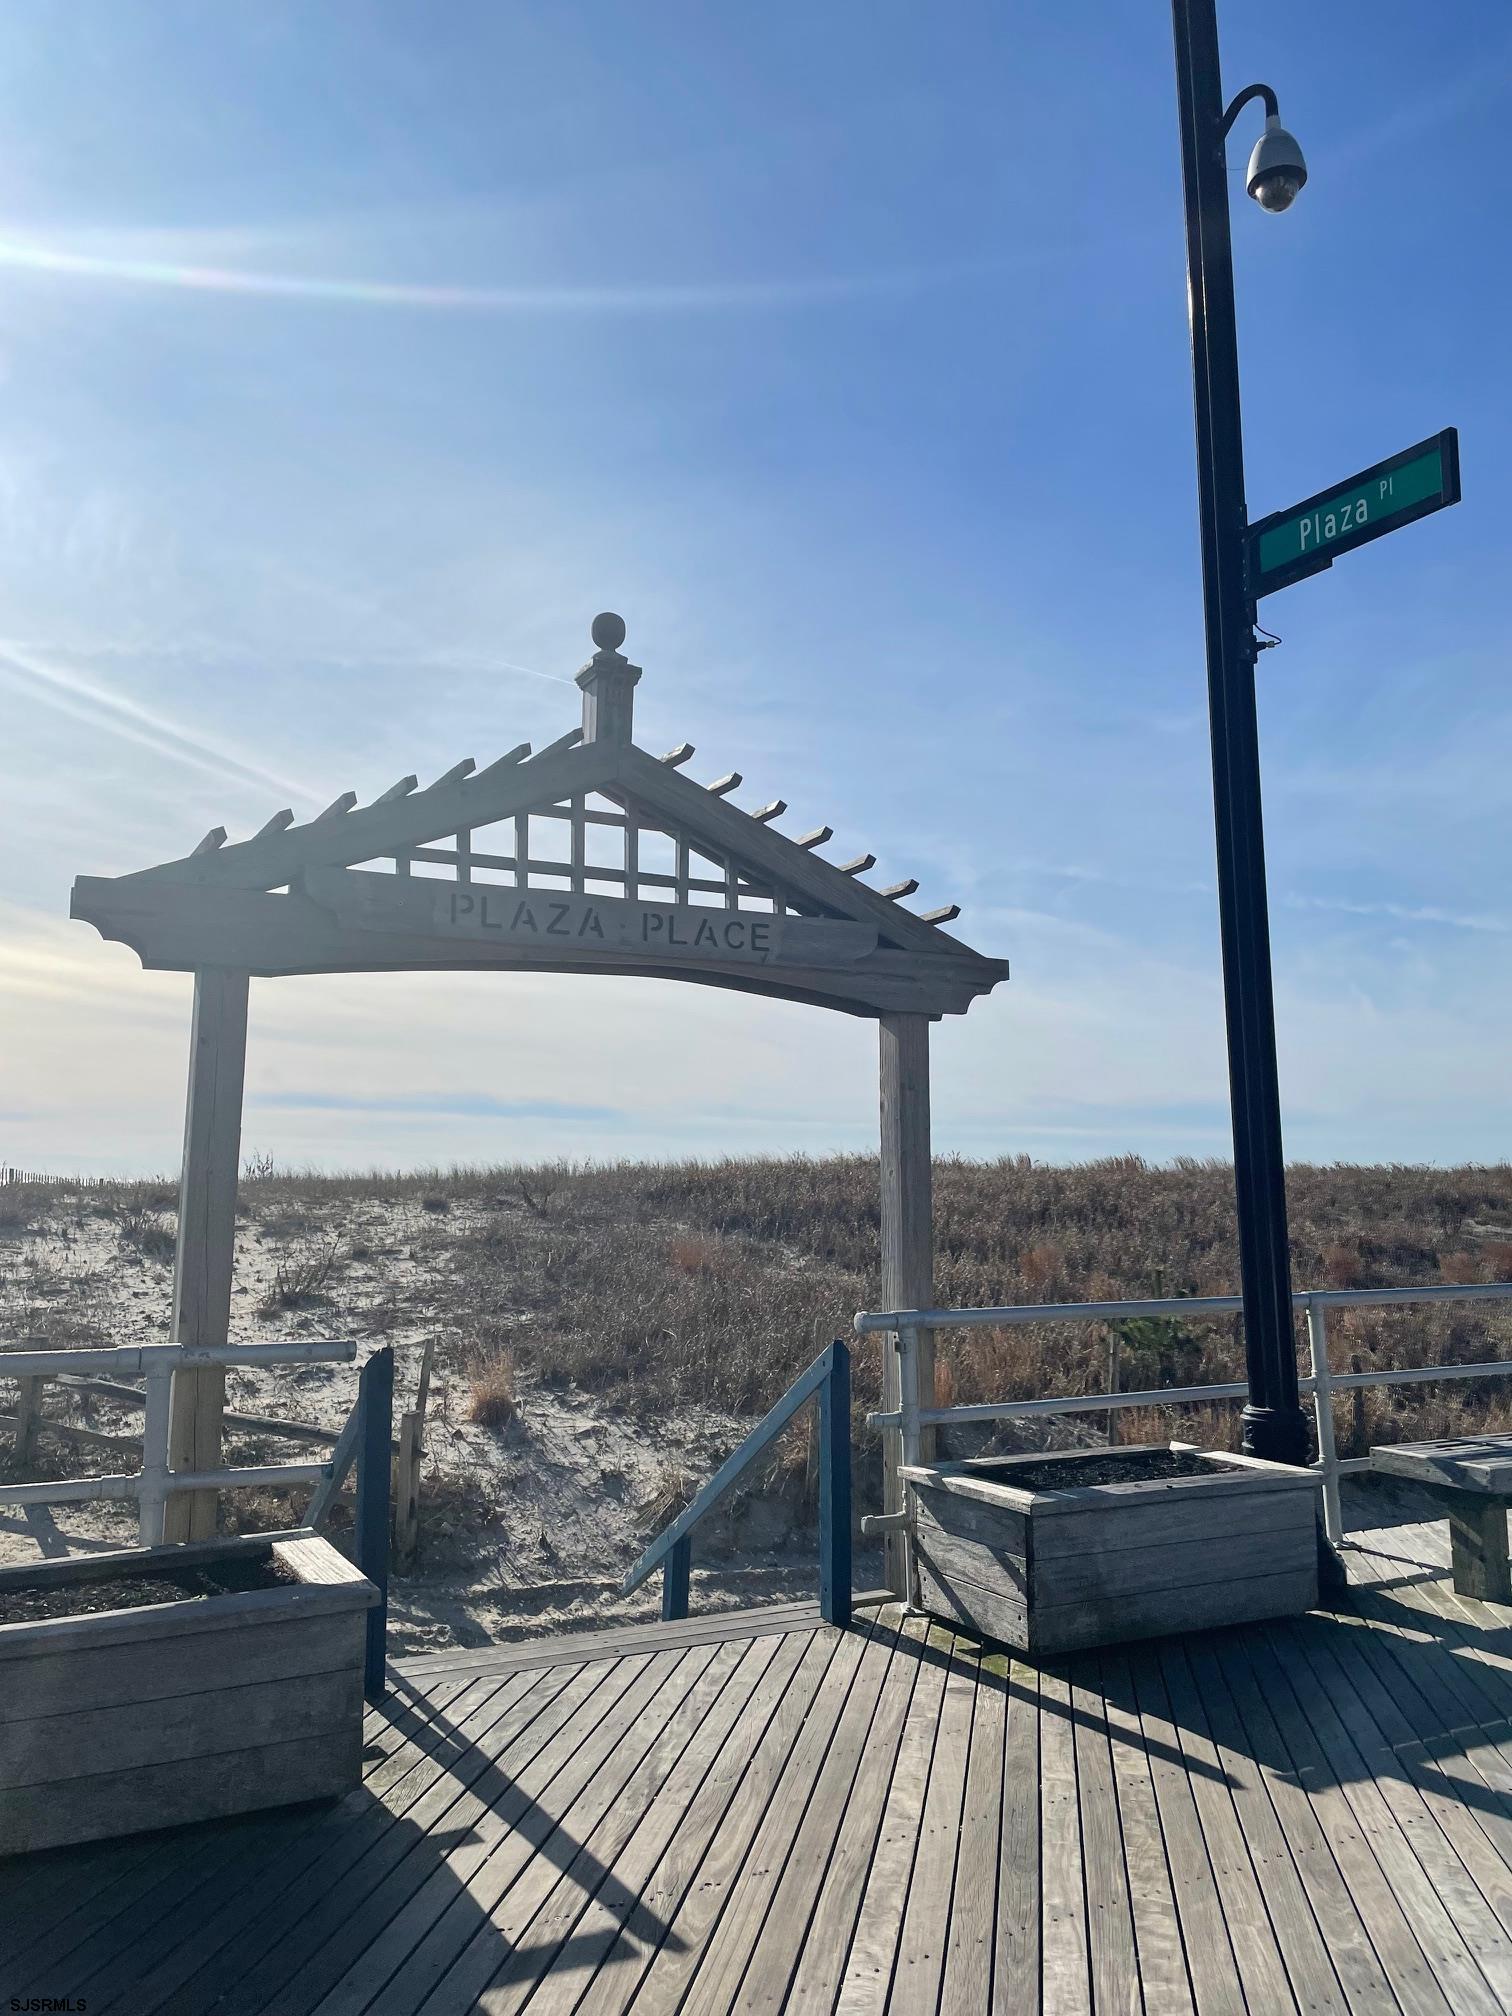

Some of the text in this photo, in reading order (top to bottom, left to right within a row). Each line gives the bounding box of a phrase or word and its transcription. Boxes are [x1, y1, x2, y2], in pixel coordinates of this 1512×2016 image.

[1300, 477, 1393, 551] Plaza Pl
[451, 893, 770, 952] PLAZA PLACE
